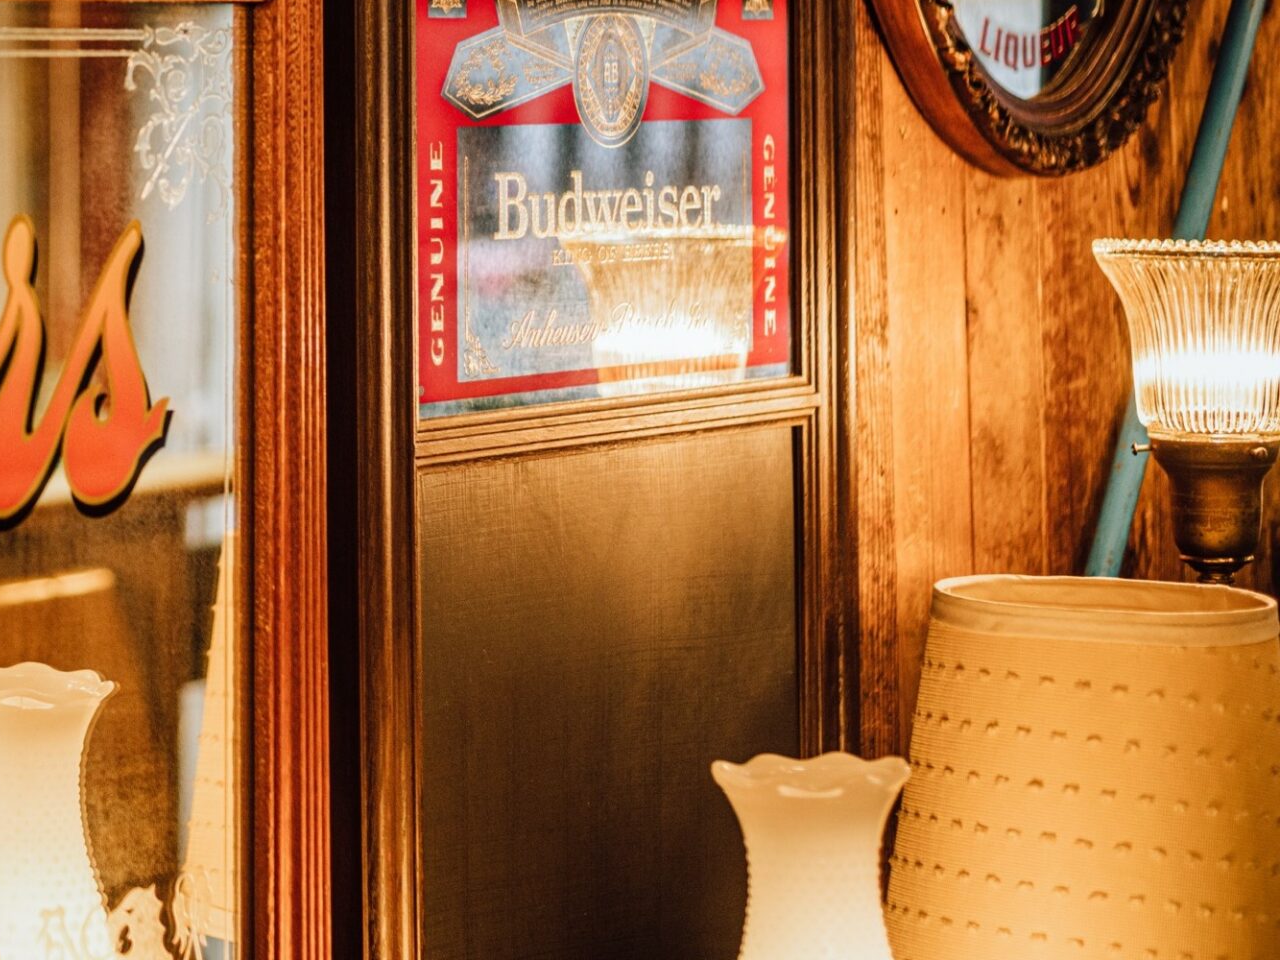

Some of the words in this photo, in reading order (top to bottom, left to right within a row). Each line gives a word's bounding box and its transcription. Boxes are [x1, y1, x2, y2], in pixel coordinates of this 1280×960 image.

[430, 141, 445, 366] GENUINE
[494, 170, 721, 242] Budweiser
[763, 134, 776, 337] GENUINE
